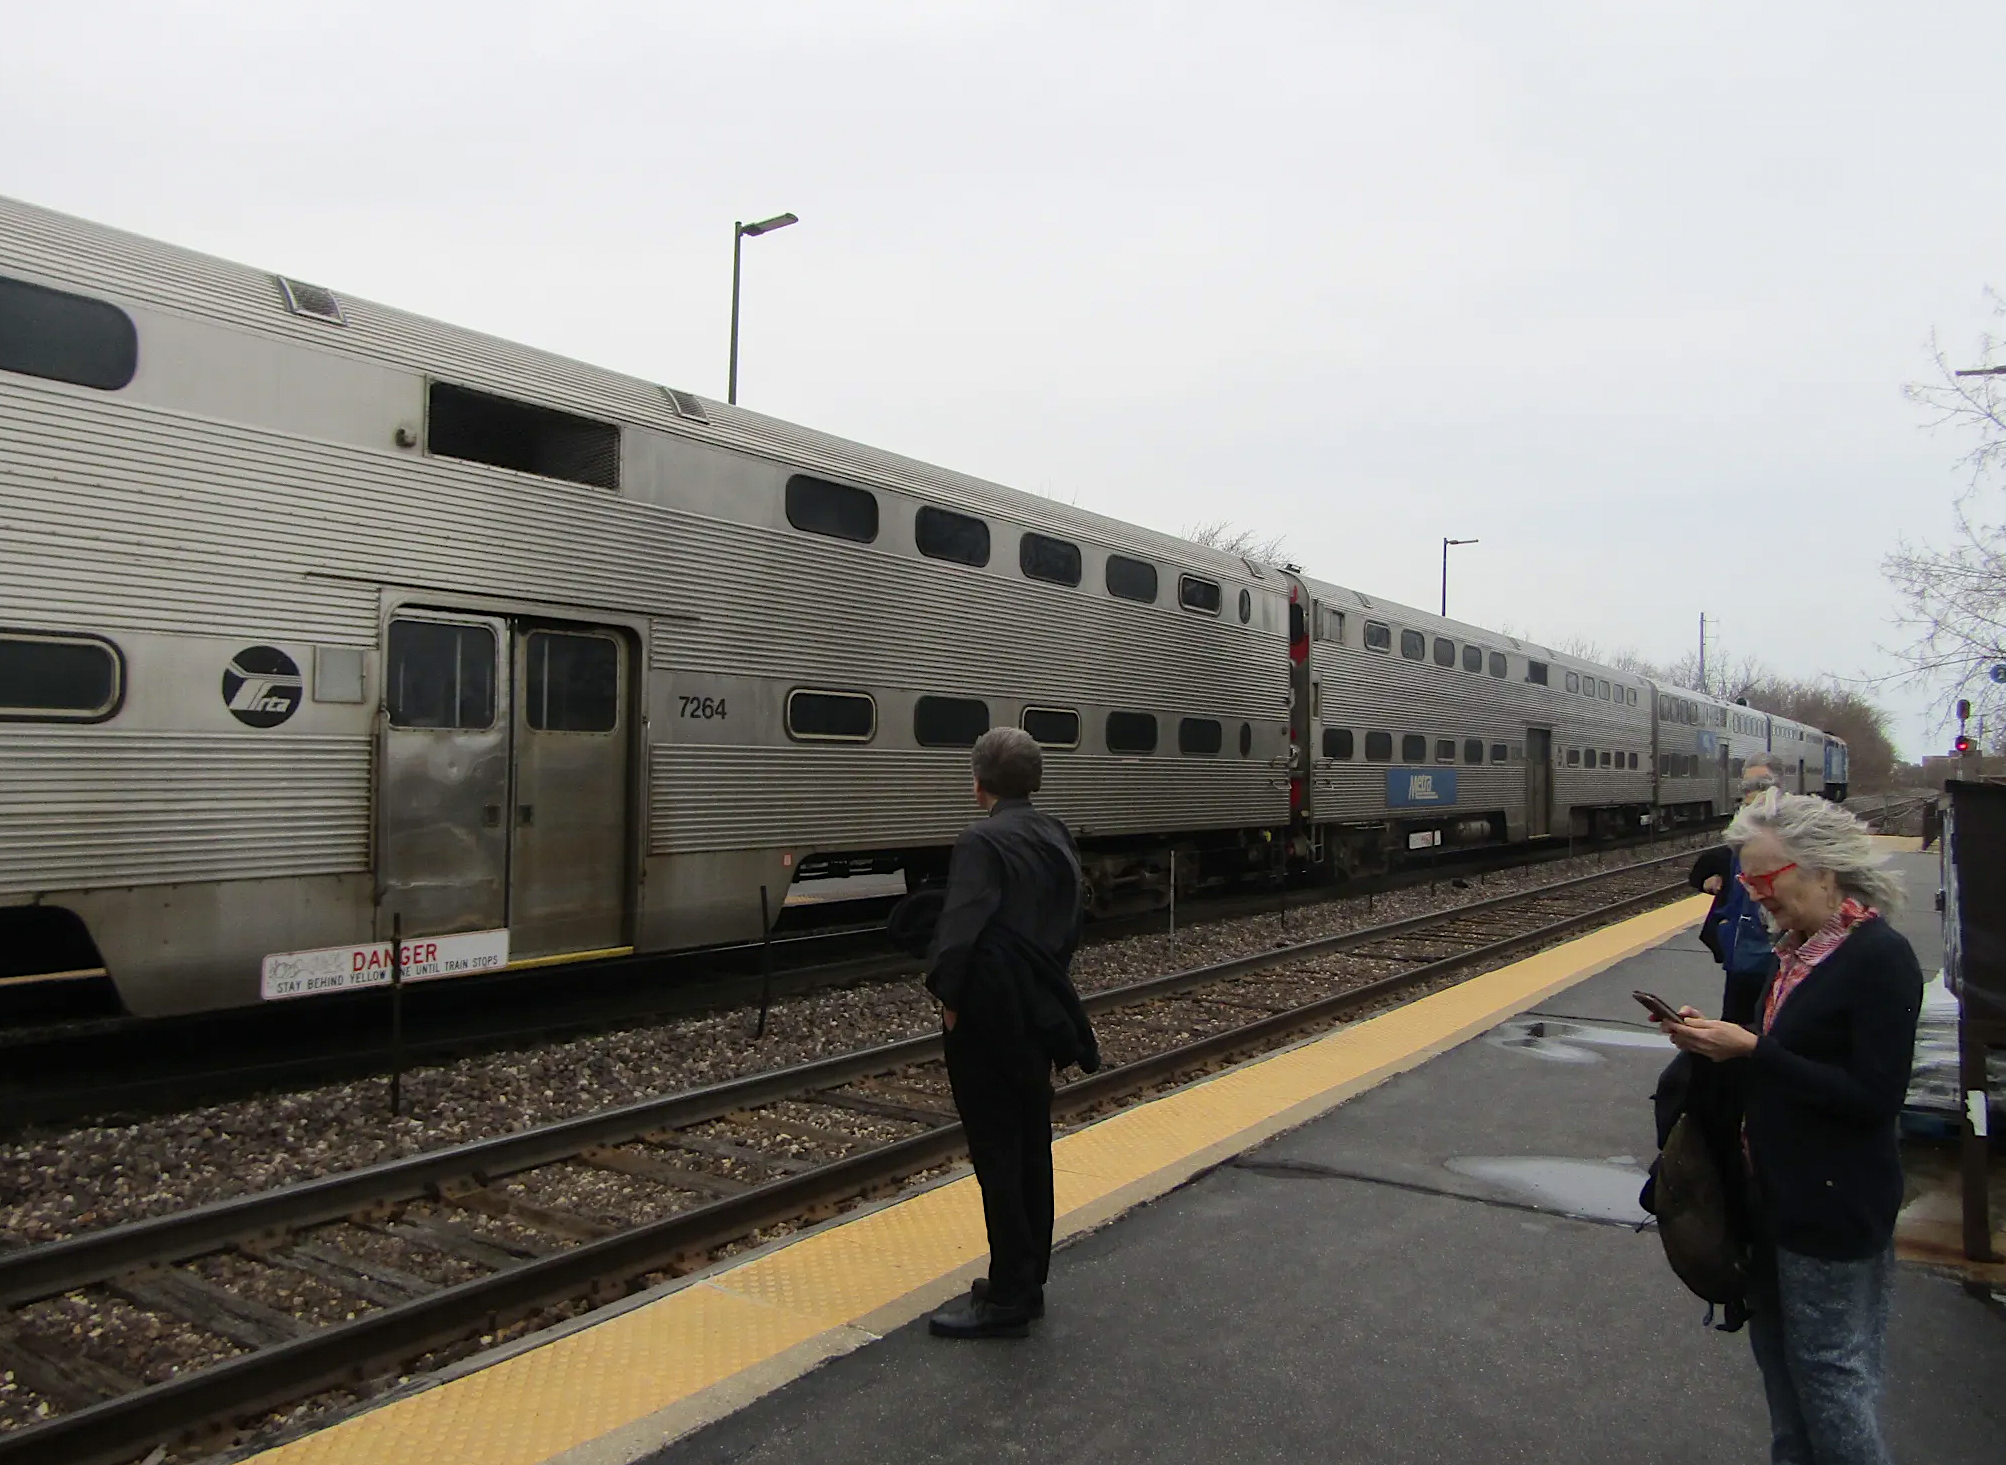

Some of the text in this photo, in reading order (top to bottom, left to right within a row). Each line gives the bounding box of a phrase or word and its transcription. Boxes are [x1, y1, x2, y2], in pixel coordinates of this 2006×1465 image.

[679, 696, 727, 720] 7264
[353, 943, 437, 972] DANGER
[277, 980, 302, 993] STAY
[307, 975, 344, 990] BEHIND
[350, 970, 386, 983] YELLOW
[416, 963, 440, 975] UNTIL
[445, 958, 468, 971] TRAIN
[473, 955, 498, 968] STOPS
